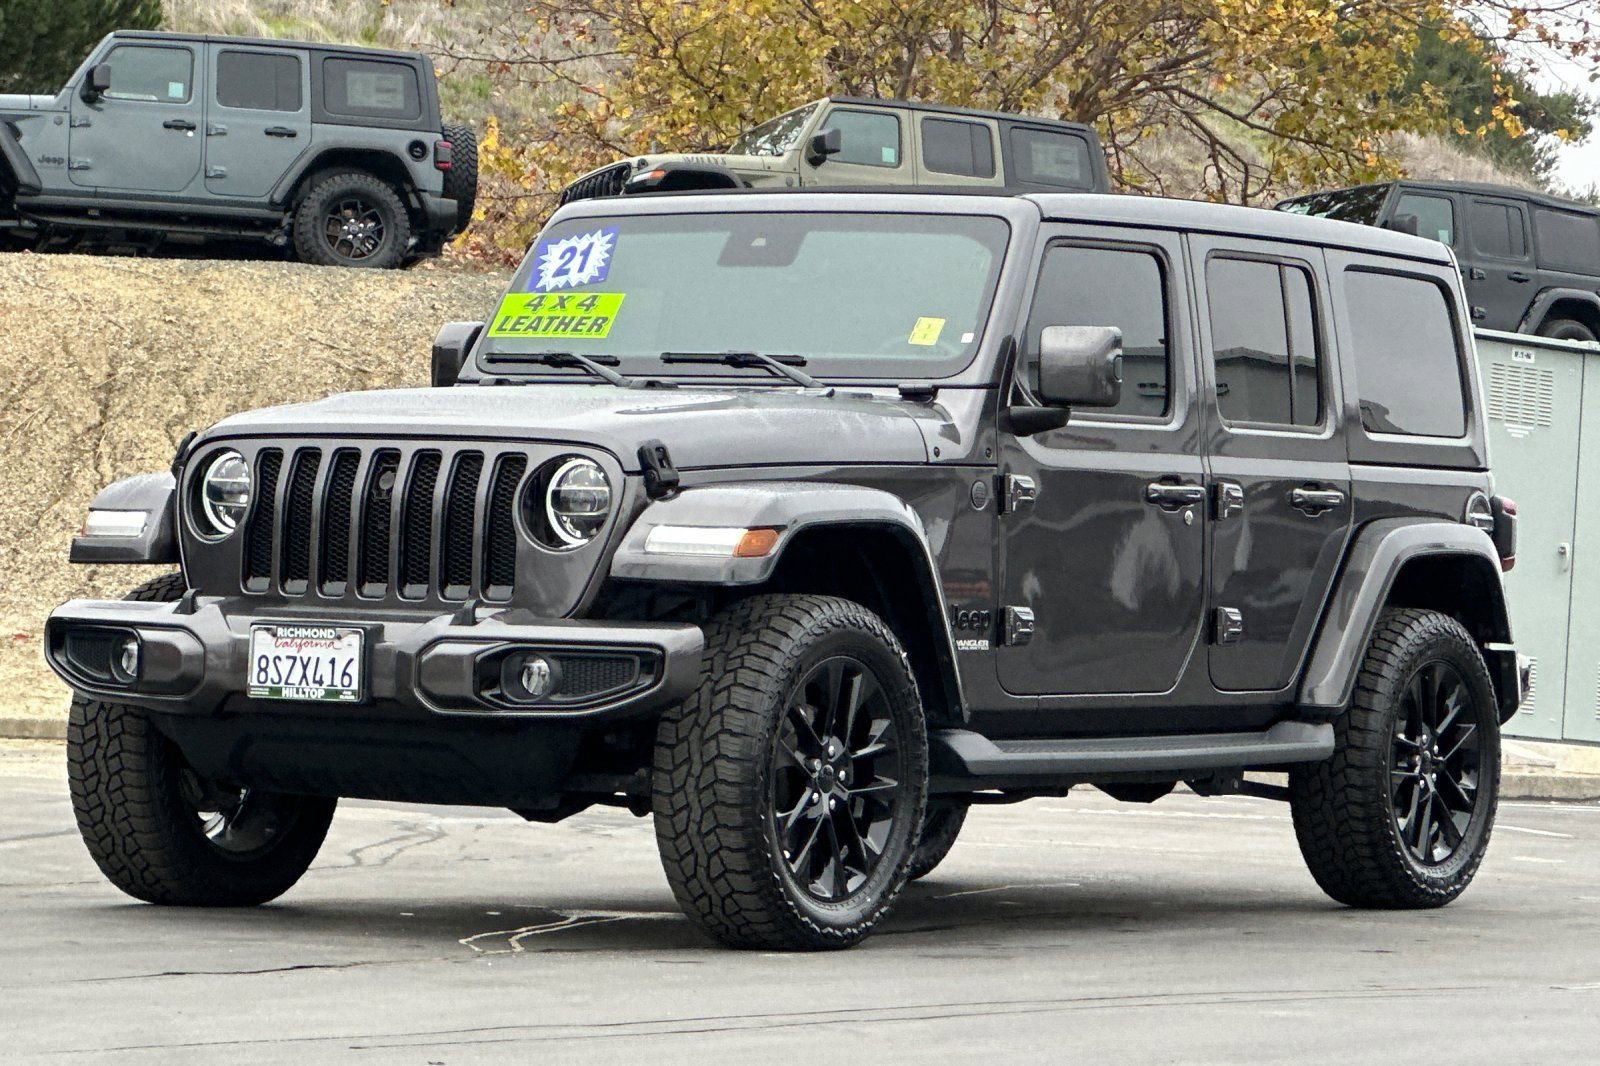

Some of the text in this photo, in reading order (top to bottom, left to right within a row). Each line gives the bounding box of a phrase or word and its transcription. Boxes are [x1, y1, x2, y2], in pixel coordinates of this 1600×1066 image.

[552, 241, 594, 278] 21
[495, 315, 609, 335] LEATHER
[951, 603, 990, 636] Jeep
[277, 628, 336, 639] RICHMOND
[274, 638, 342, 653] California
[256, 654, 355, 688] 8SZX416
[281, 687, 326, 699] HILLTOP
